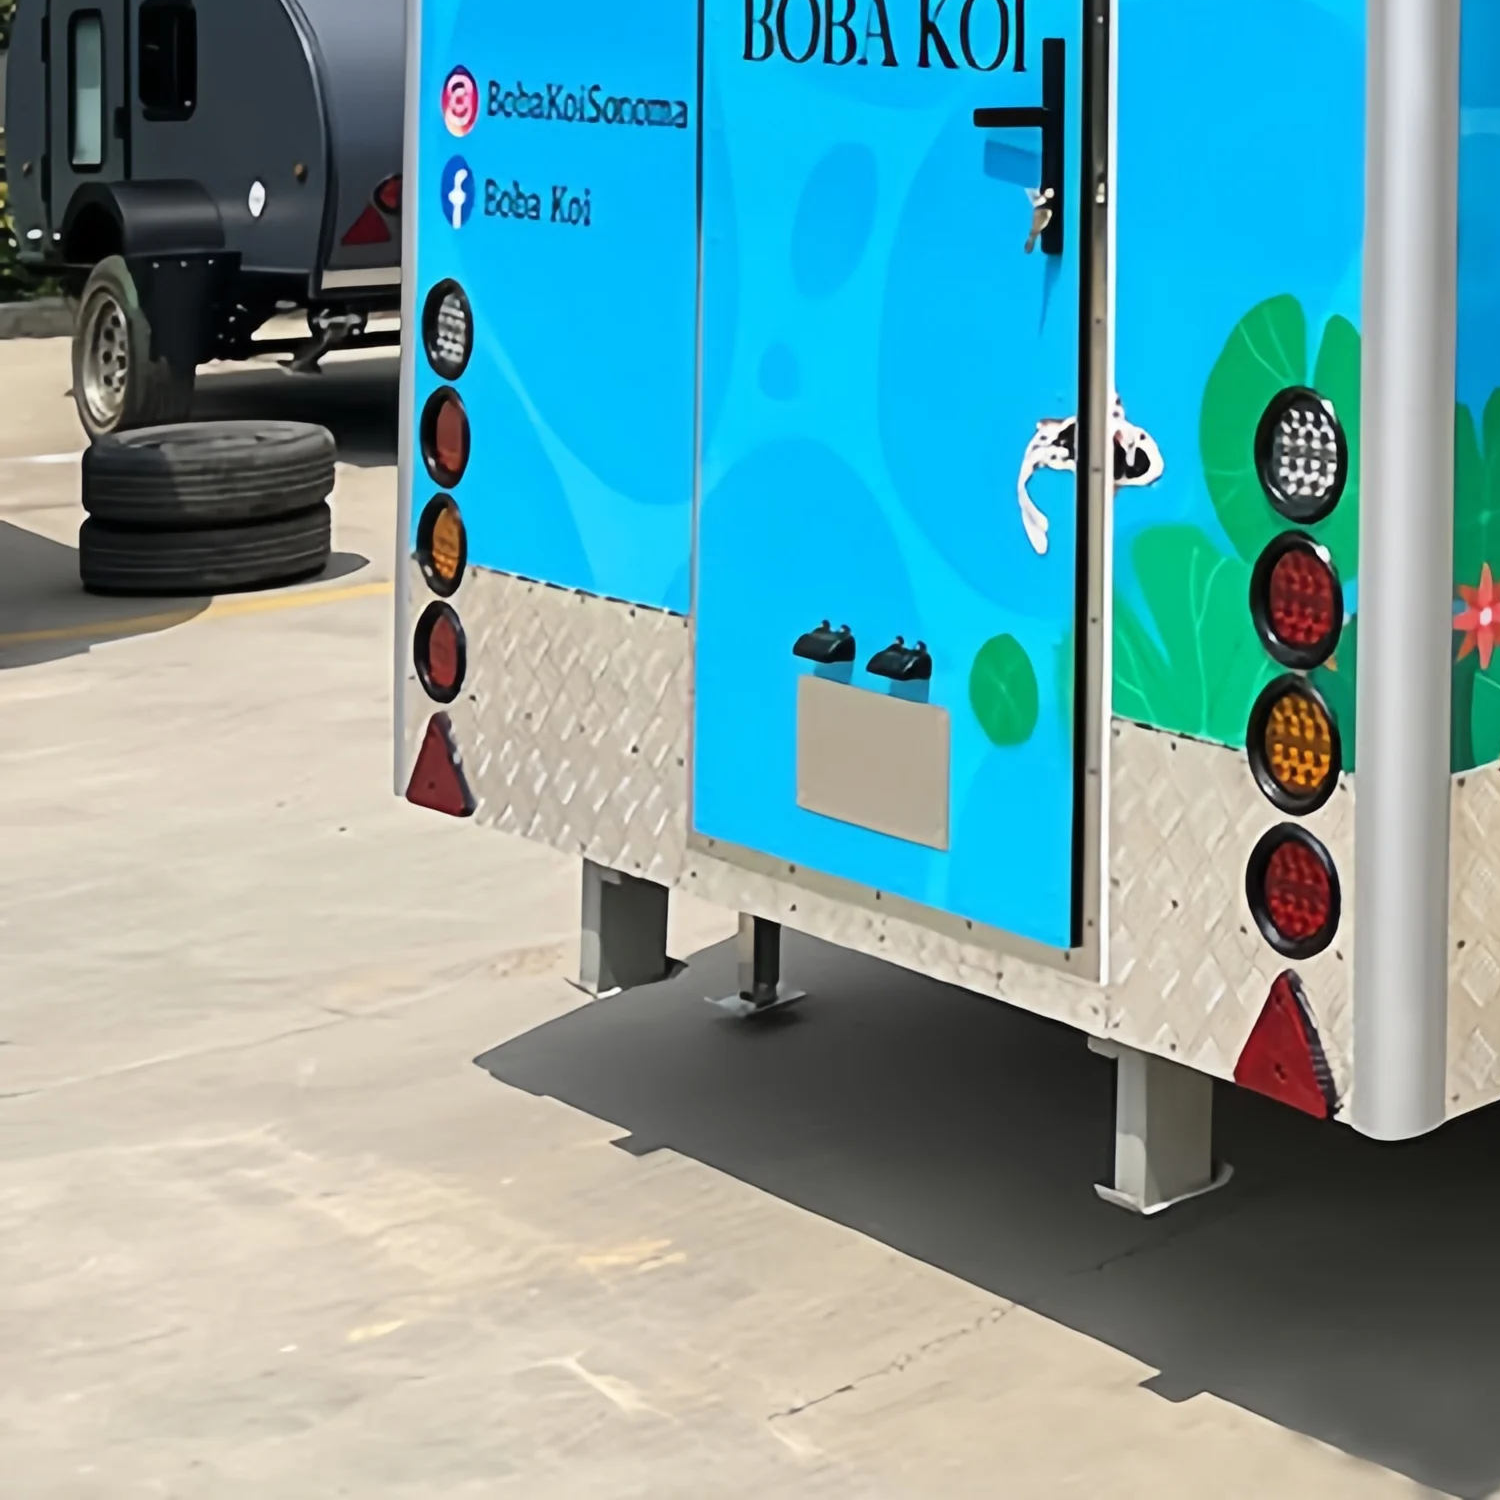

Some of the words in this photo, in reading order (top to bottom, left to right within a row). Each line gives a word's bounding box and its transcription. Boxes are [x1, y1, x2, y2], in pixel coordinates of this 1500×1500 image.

[486, 79, 689, 129] BobaKoiSonoma
[484, 178, 542, 221] Boba
[550, 185, 592, 227] Koi
